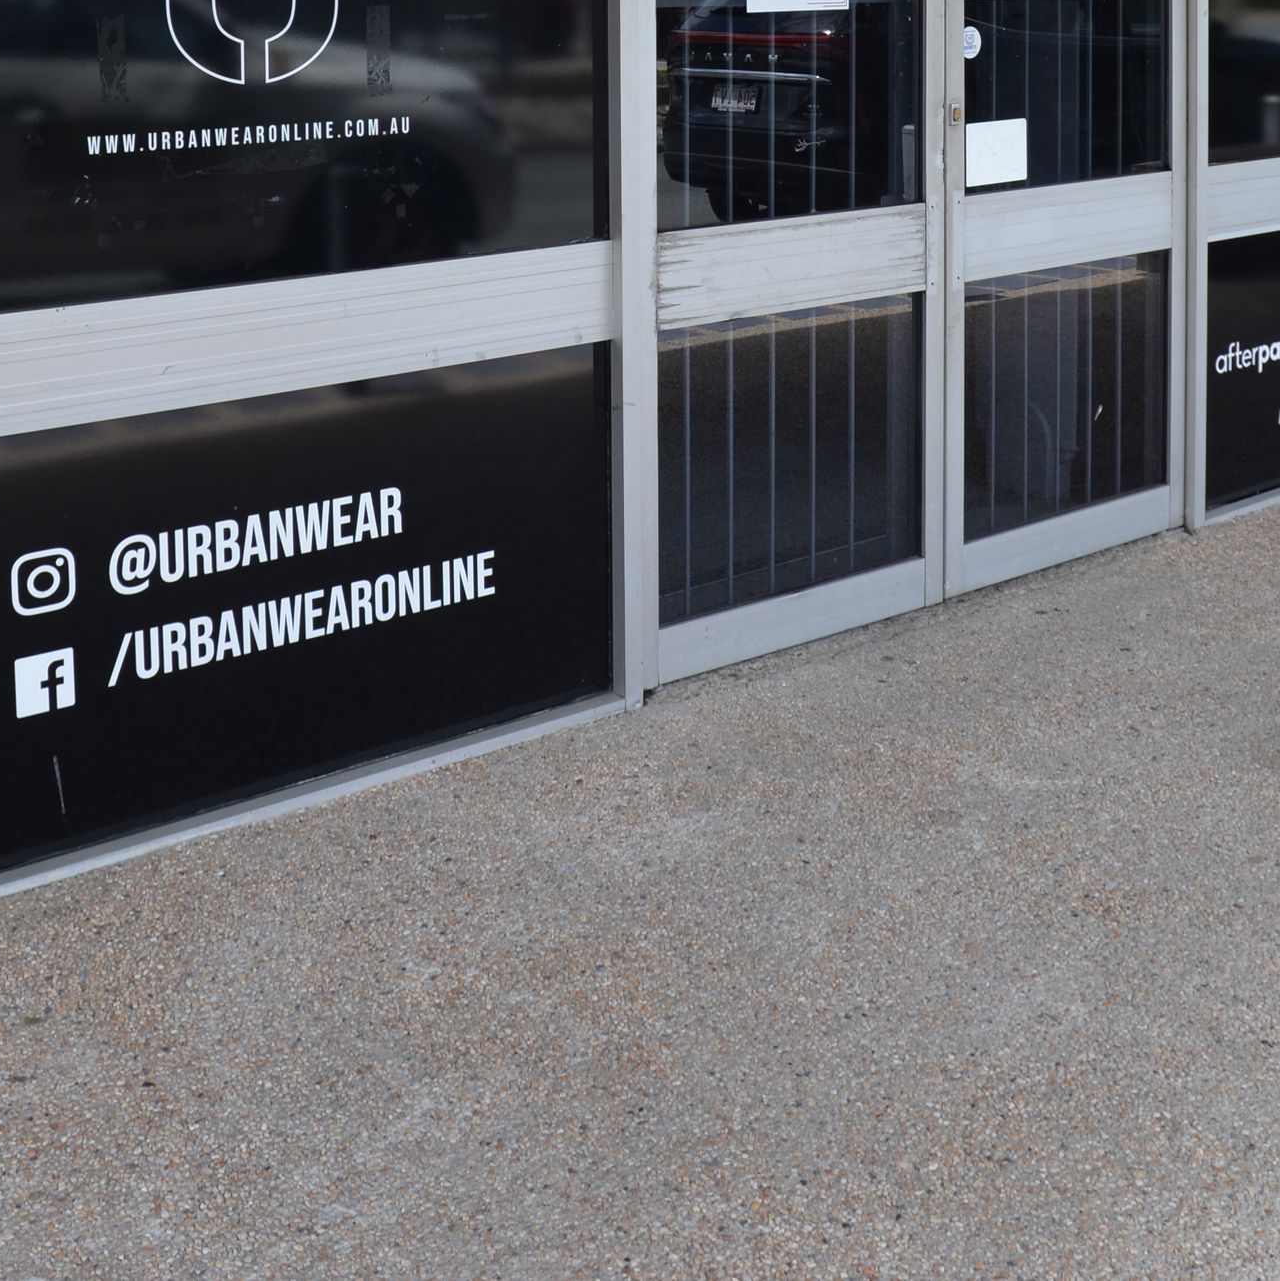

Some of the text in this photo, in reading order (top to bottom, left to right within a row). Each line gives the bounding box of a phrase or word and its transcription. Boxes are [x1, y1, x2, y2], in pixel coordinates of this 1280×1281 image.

[86, 116, 411, 156] WWW.URBANWEARONLINE.COM.AU
[108, 486, 403, 596] @URBANWEAR
[107, 549, 496, 688] /URBANWEARONLINE
